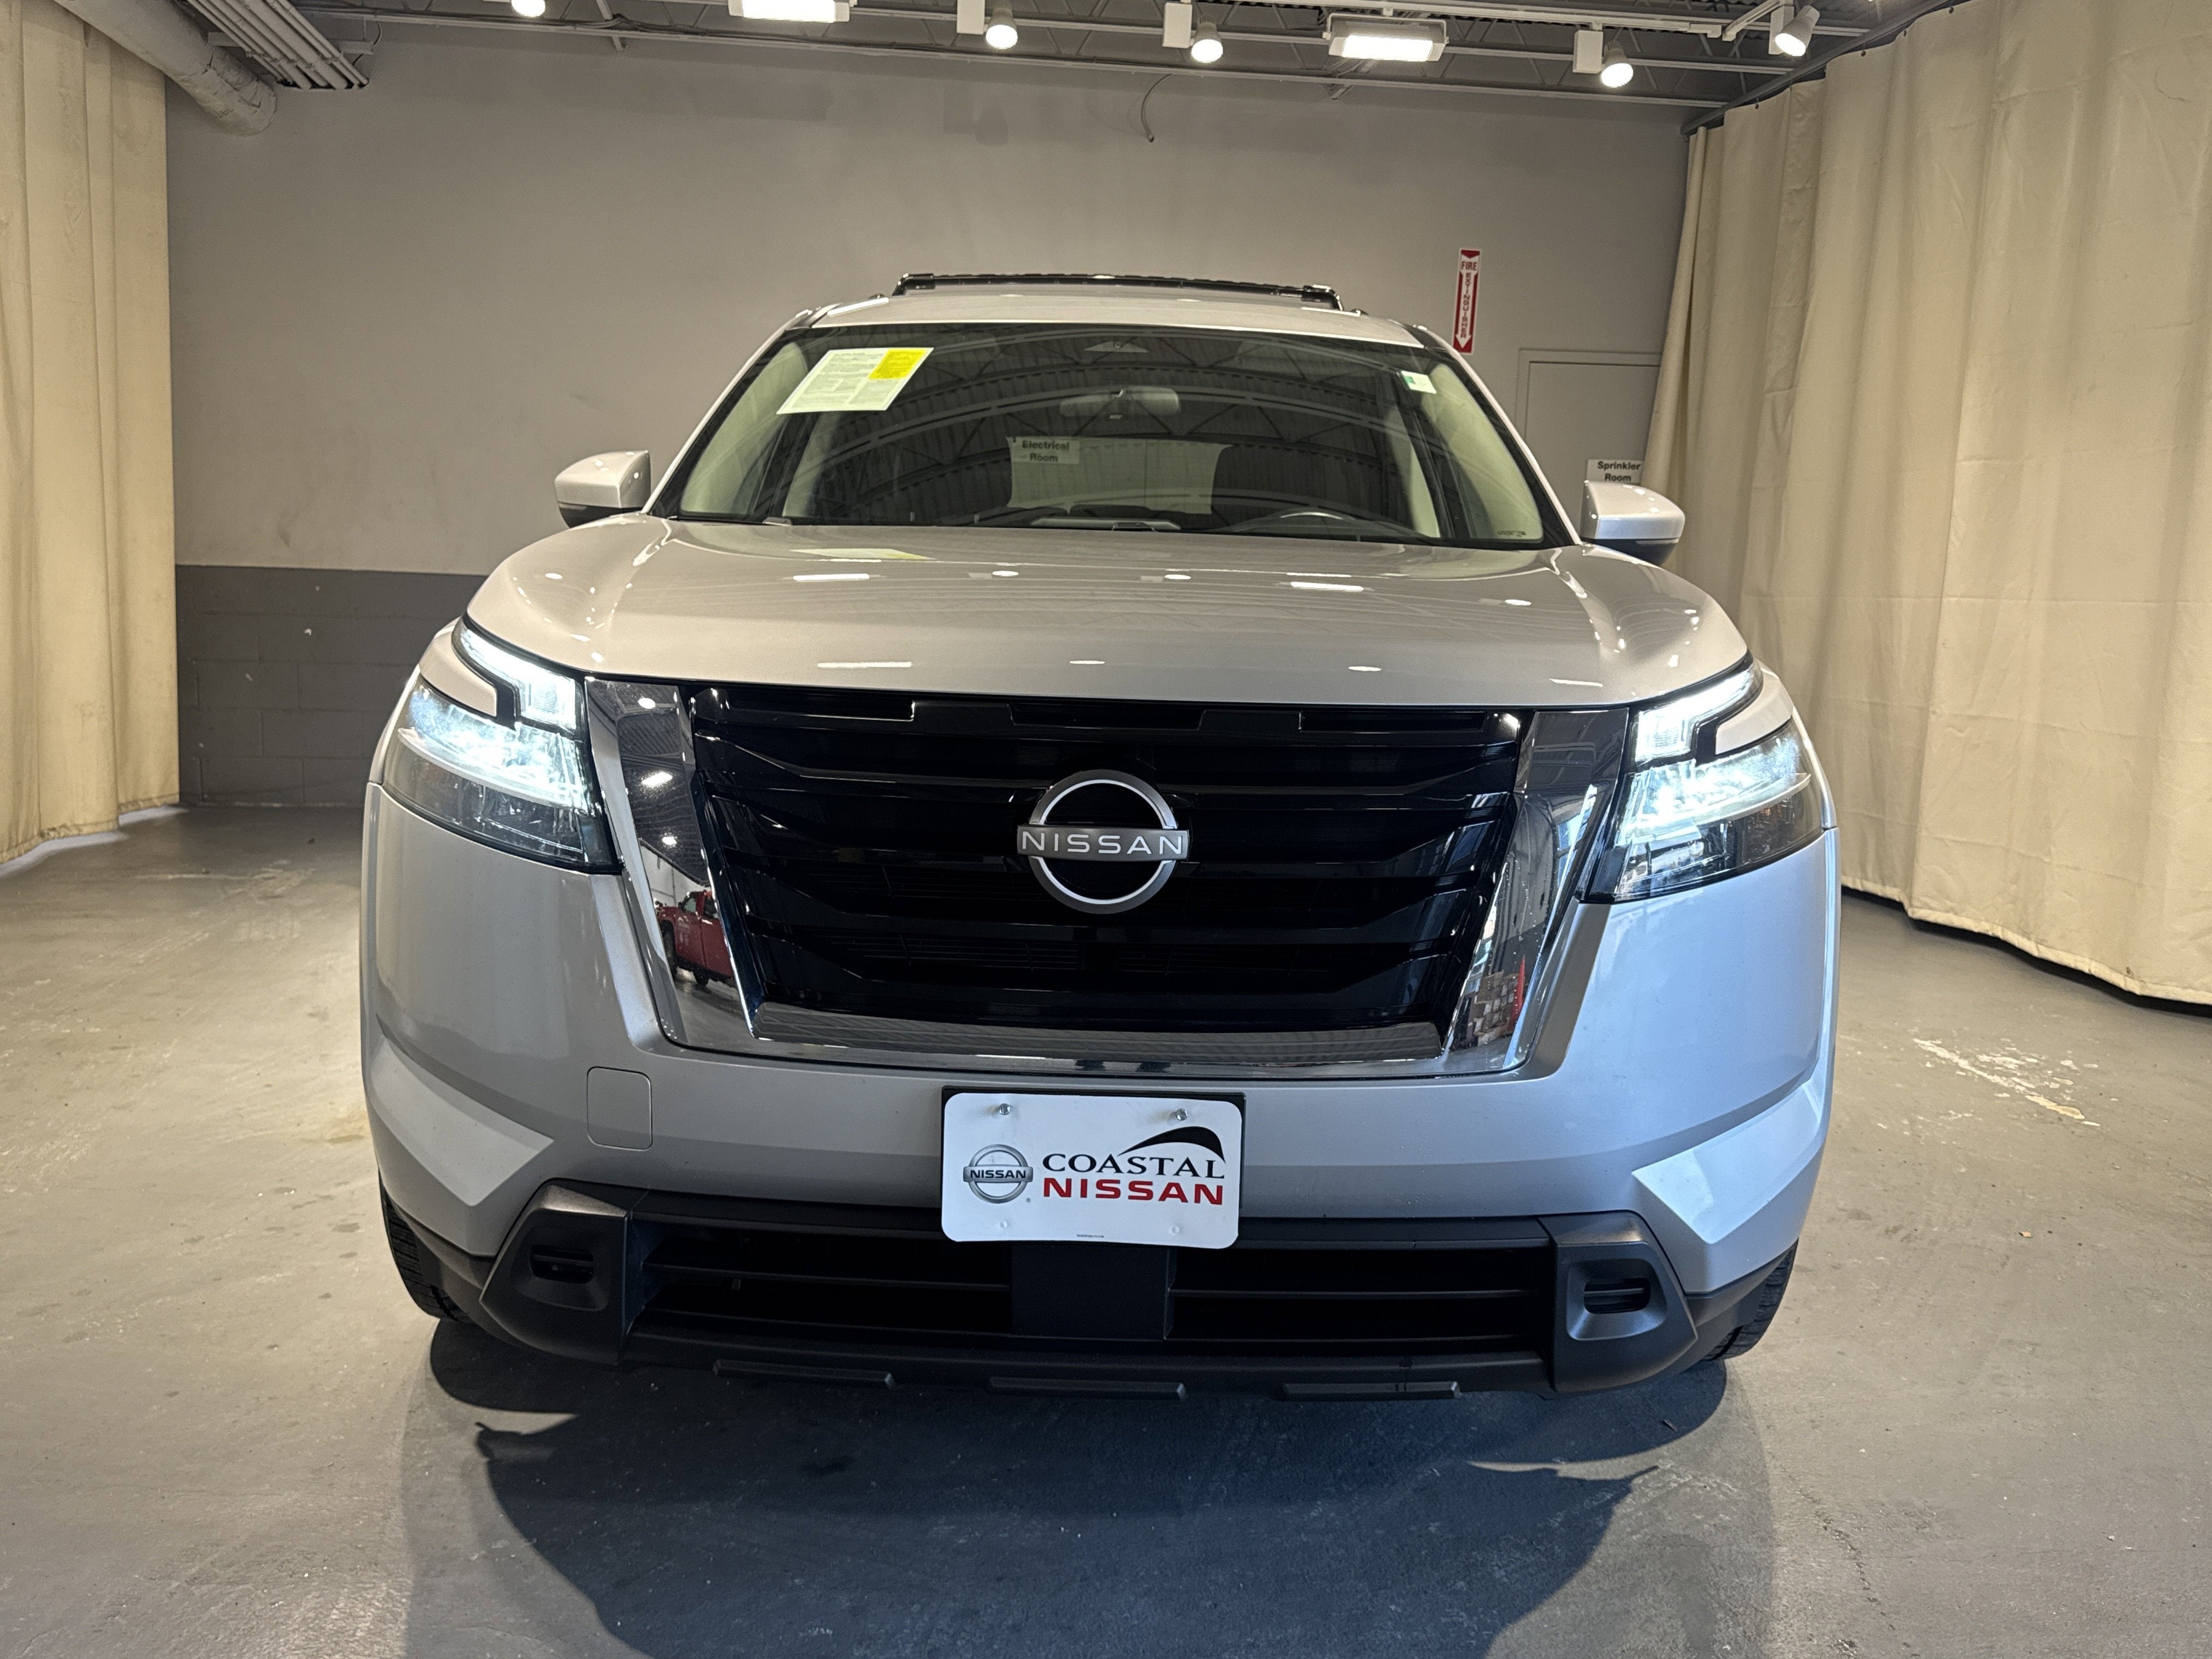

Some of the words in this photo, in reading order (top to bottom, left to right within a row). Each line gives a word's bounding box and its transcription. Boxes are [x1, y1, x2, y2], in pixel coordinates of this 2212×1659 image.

[1462, 261, 1477, 271] FIRE
[1460, 273, 1471, 338] EXTINGUISHER
[1022, 441, 1070, 450] Electrical
[1030, 453, 1058, 461] Room
[1598, 461, 1641, 471] Sprinkler
[1605, 473, 1632, 482] Room
[1022, 831, 1182, 855] NISSAN
[1042, 1153, 1225, 1179] COASTAL
[970, 1170, 1026, 1178] NISSAN
[1043, 1177, 1223, 1205] NISSAN
